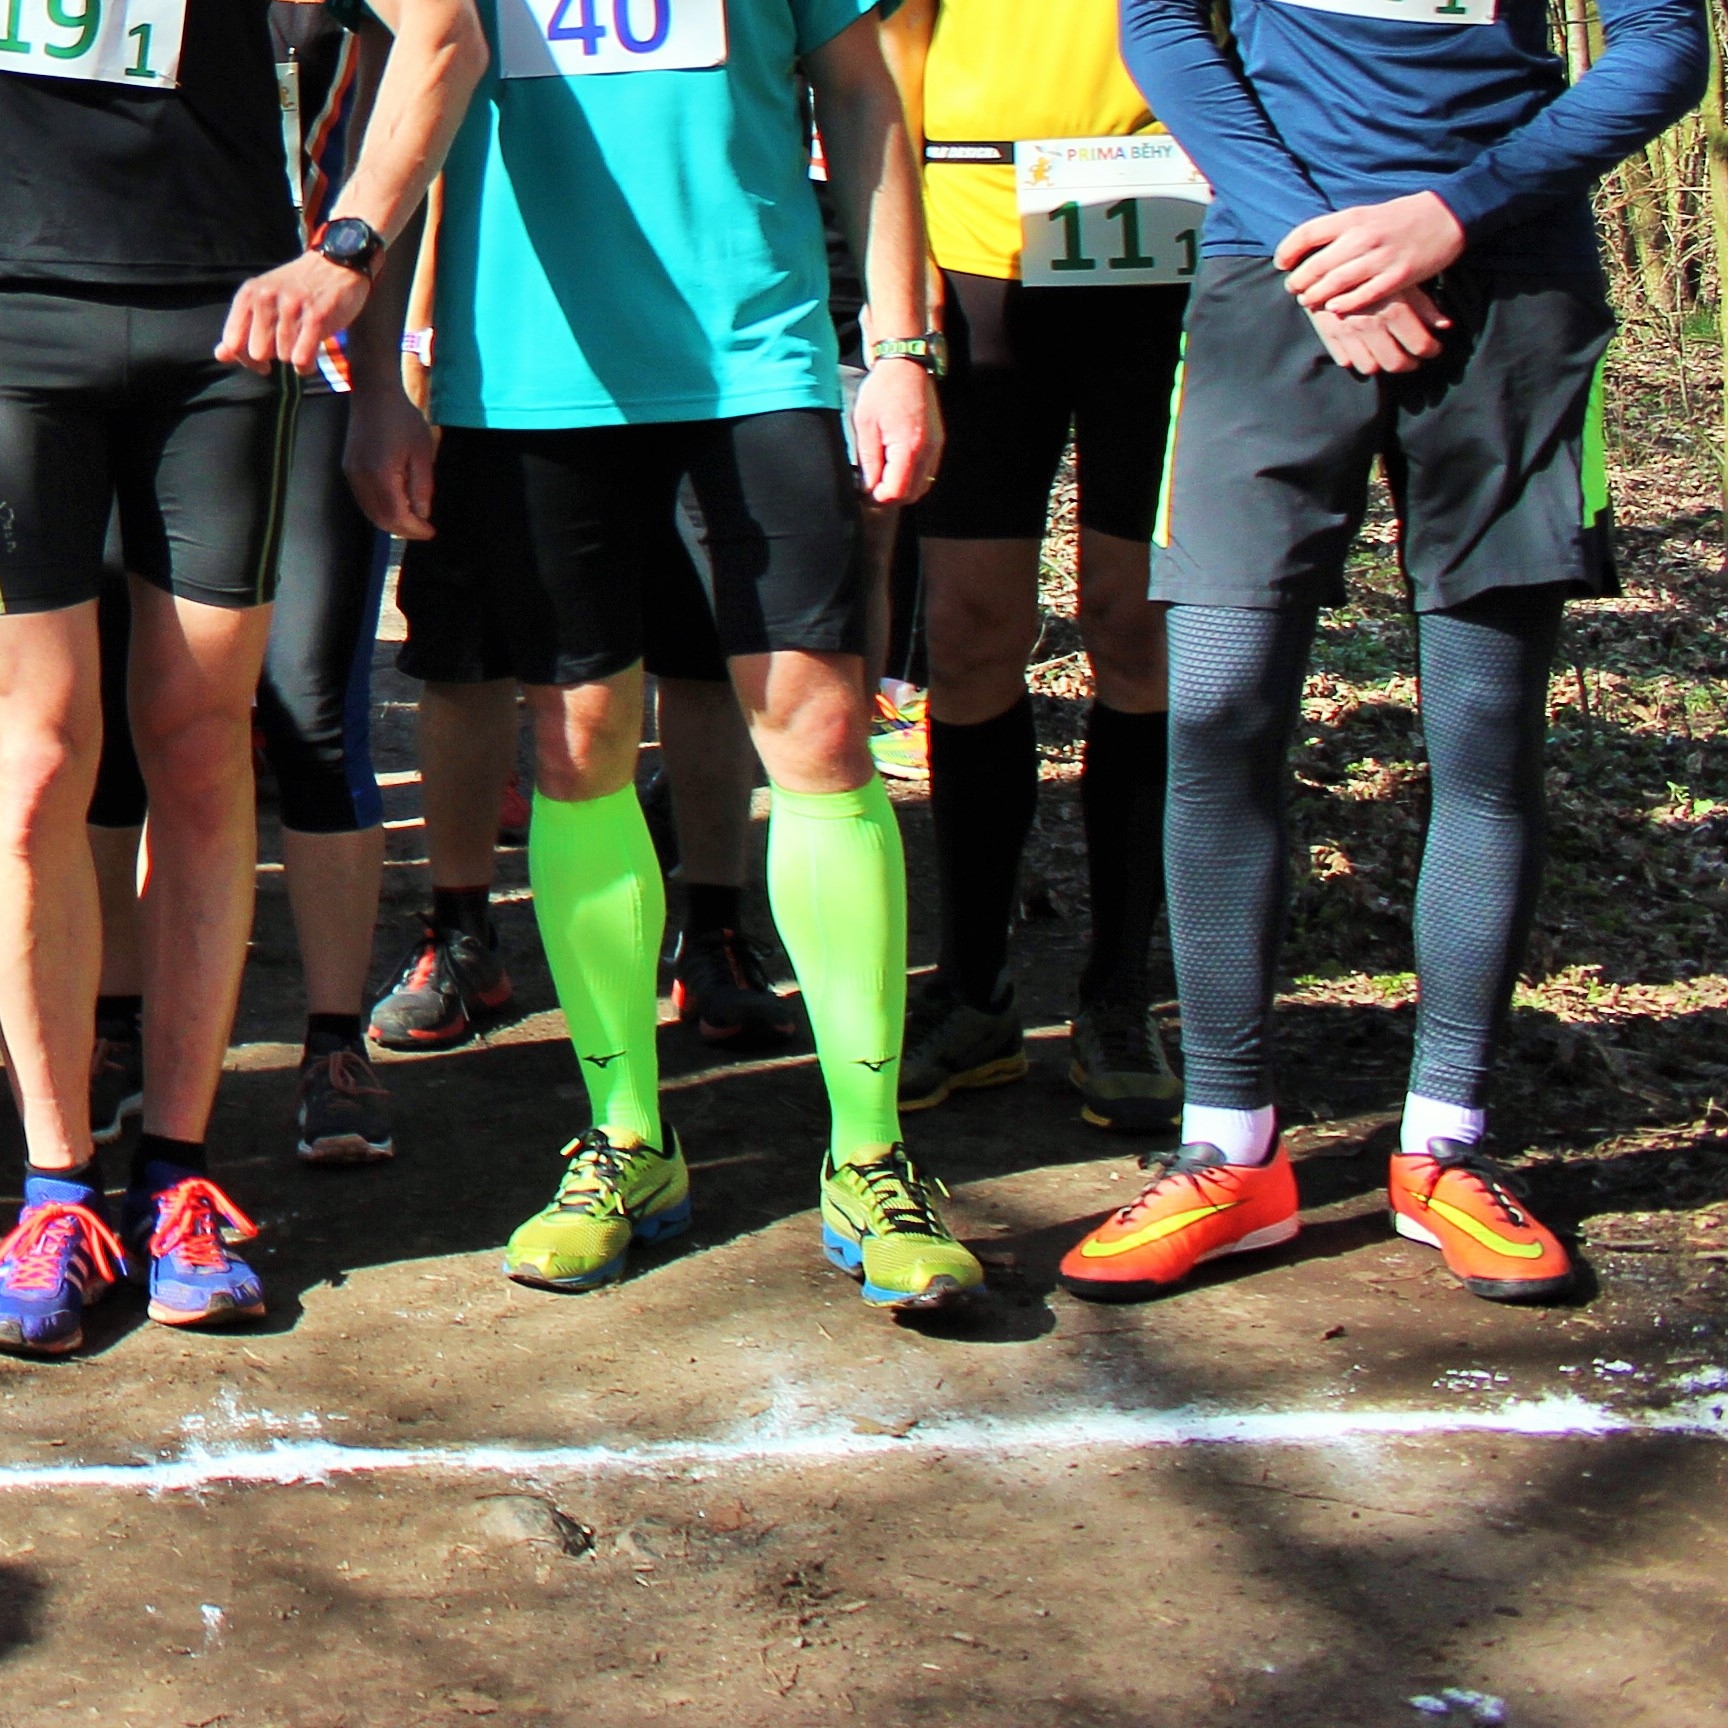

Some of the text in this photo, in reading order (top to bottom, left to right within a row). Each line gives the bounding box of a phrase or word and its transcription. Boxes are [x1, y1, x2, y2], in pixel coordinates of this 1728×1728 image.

[124, 23, 157, 79] 1
[1066, 143, 1174, 161] PRIMA BĚHY
[1048, 197, 1197, 275] 11 1
